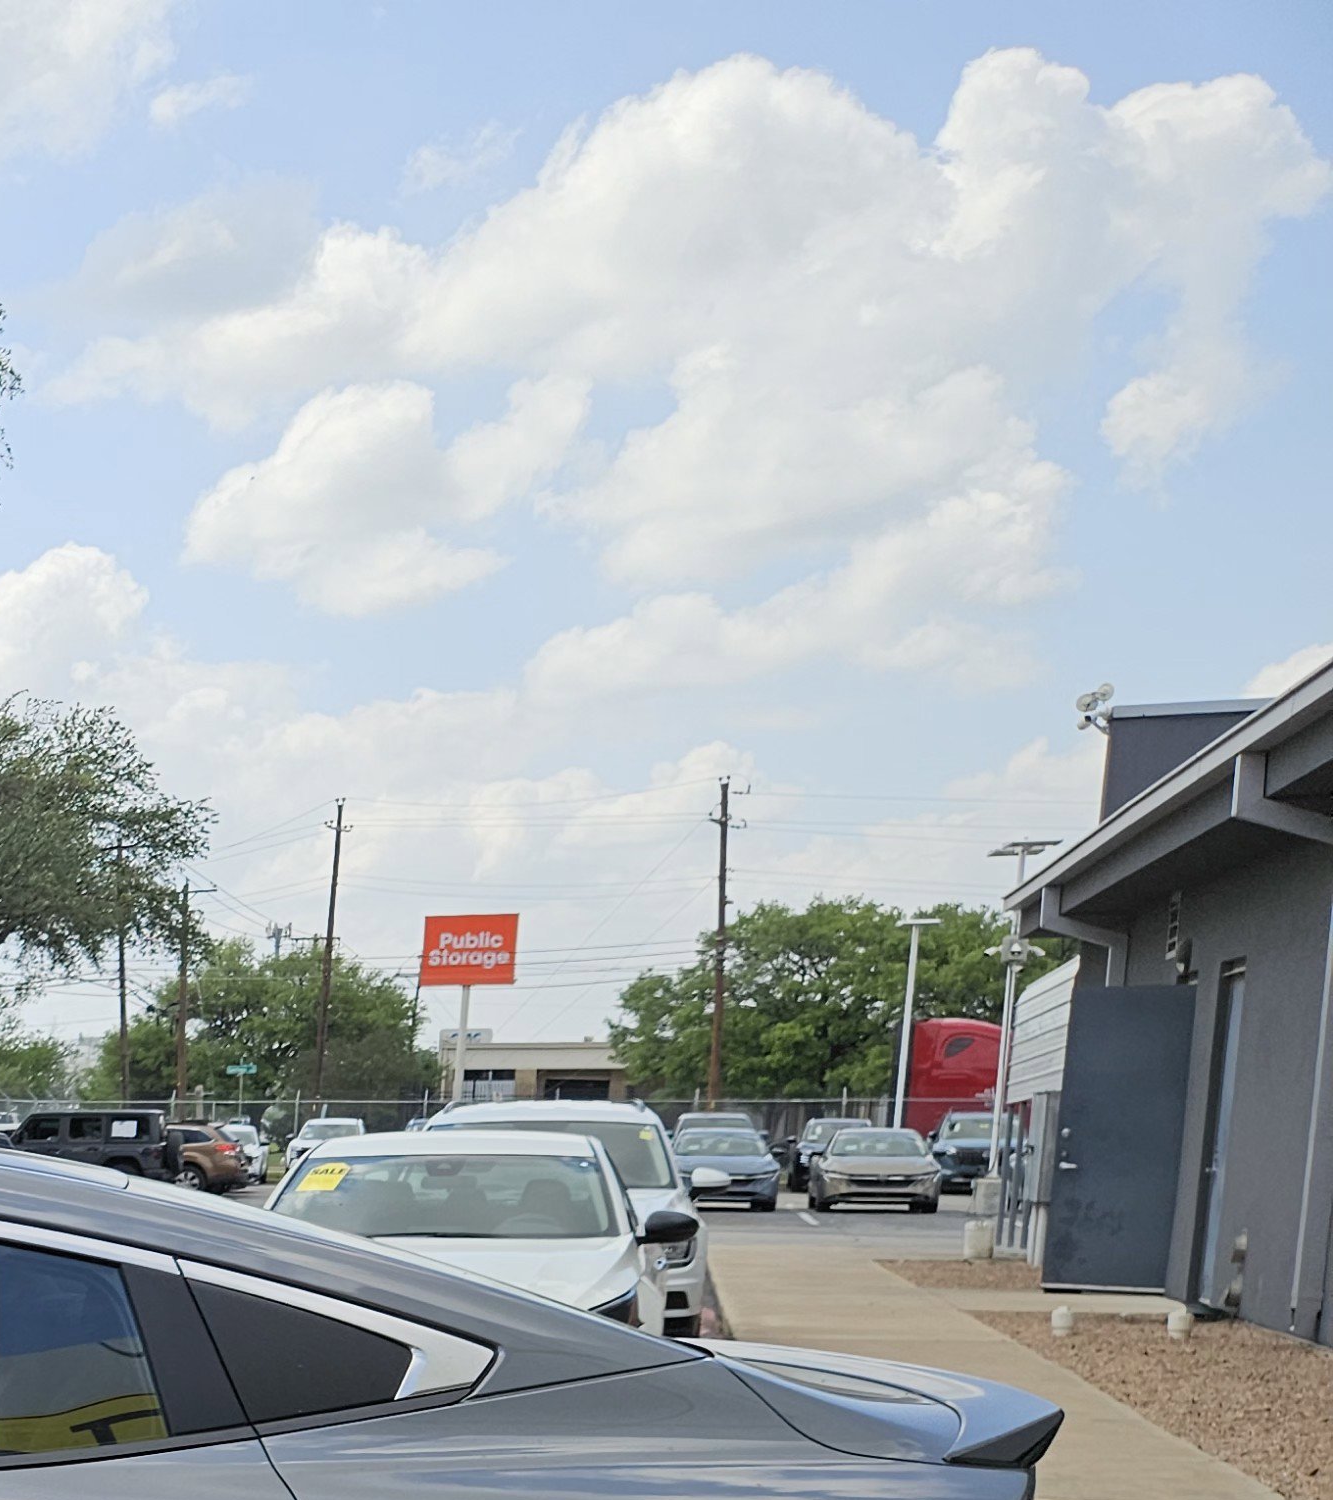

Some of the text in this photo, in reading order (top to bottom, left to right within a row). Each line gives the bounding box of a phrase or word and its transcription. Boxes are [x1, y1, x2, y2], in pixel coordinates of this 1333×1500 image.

[439, 931, 504, 949] Public
[428, 949, 510, 969] Storage
[312, 1167, 347, 1175] SALE
